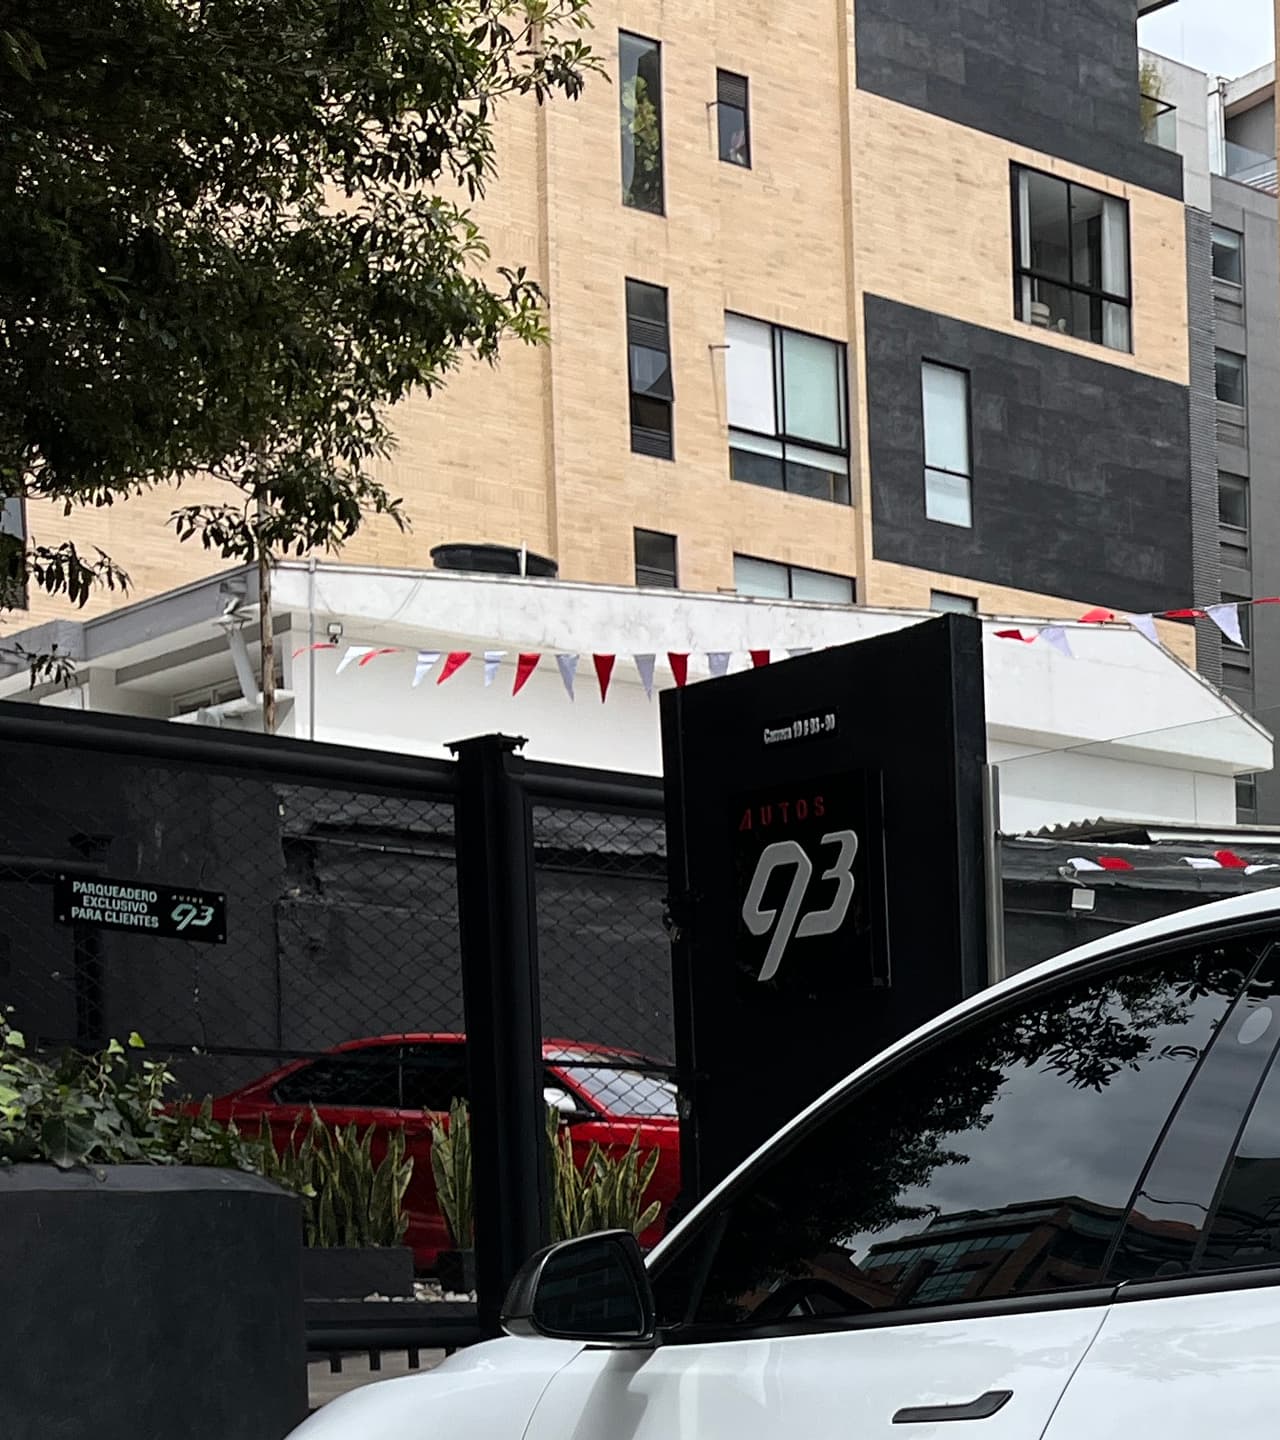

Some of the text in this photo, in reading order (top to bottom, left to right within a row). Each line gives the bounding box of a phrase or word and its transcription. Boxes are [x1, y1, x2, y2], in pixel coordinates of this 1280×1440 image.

[738, 797, 826, 831] AUTOS
[72, 880, 158, 903] PARQUEADERO
[83, 895, 148, 914] EXCLUSIVO
[170, 903, 215, 931] 93
[742, 829, 858, 981] 93
[71, 906, 160, 929] PARA CLIENTES
